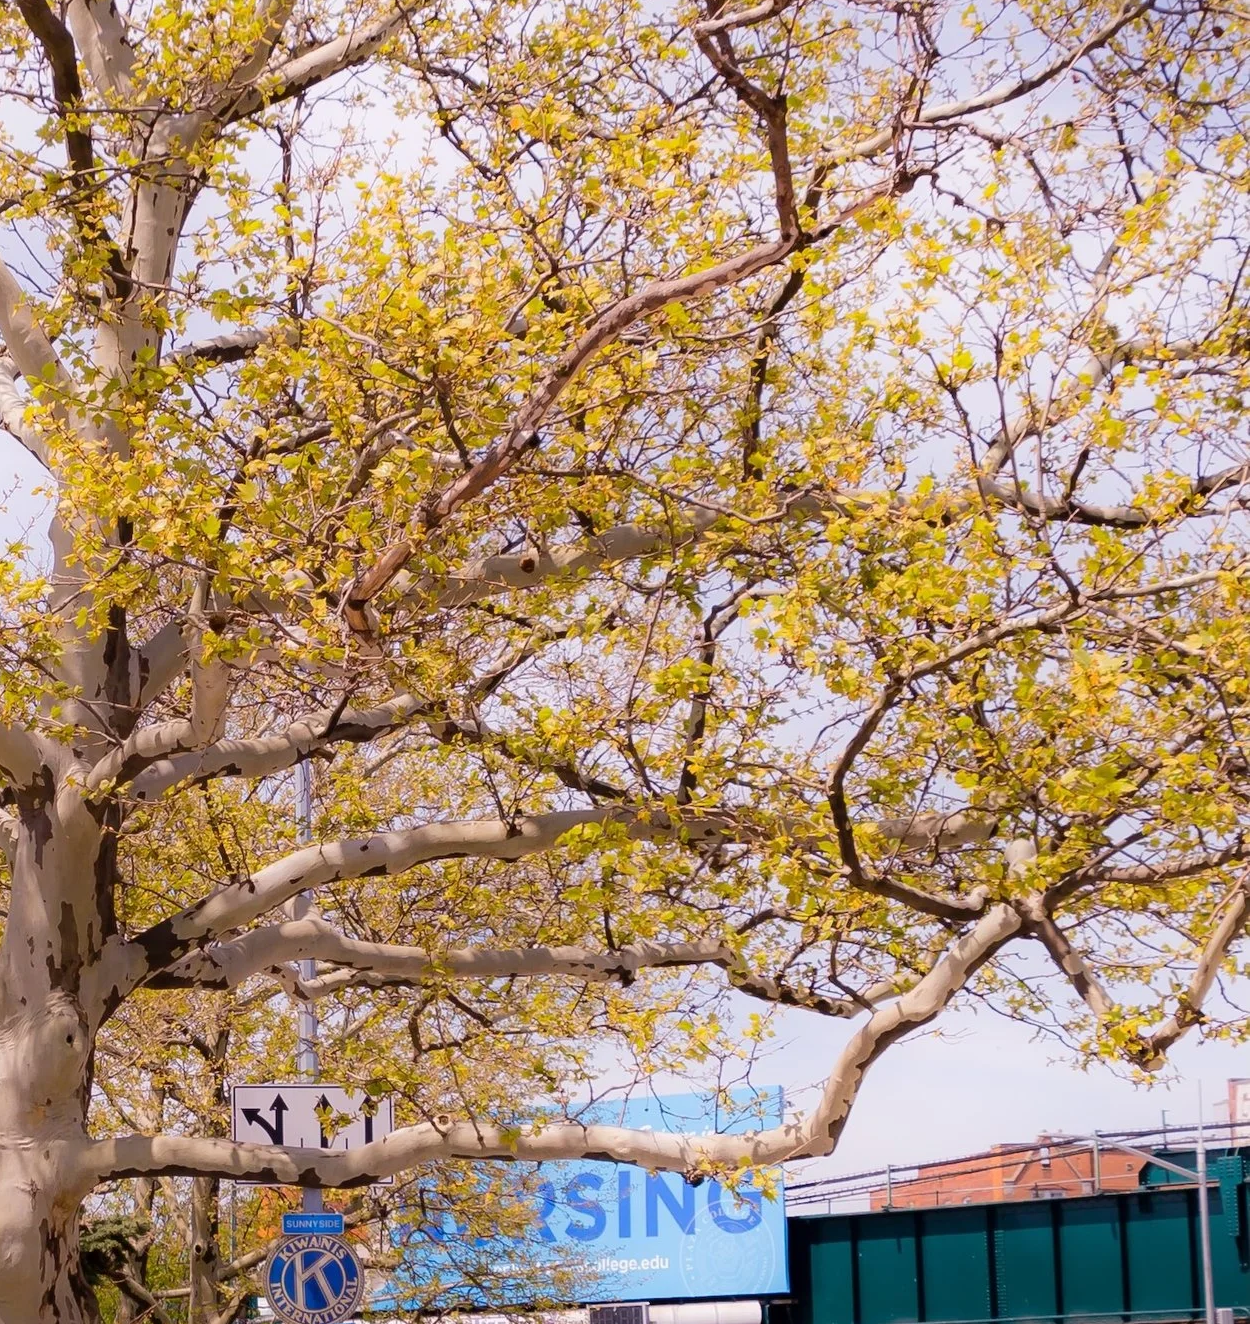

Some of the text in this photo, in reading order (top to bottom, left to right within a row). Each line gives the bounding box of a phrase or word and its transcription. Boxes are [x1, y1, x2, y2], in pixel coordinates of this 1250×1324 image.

[286, 1219, 340, 1228] SUNNYSIDE
[278, 1236, 347, 1263] KIWANIS
[270, 1276, 358, 1324] INTERNATIONAL
